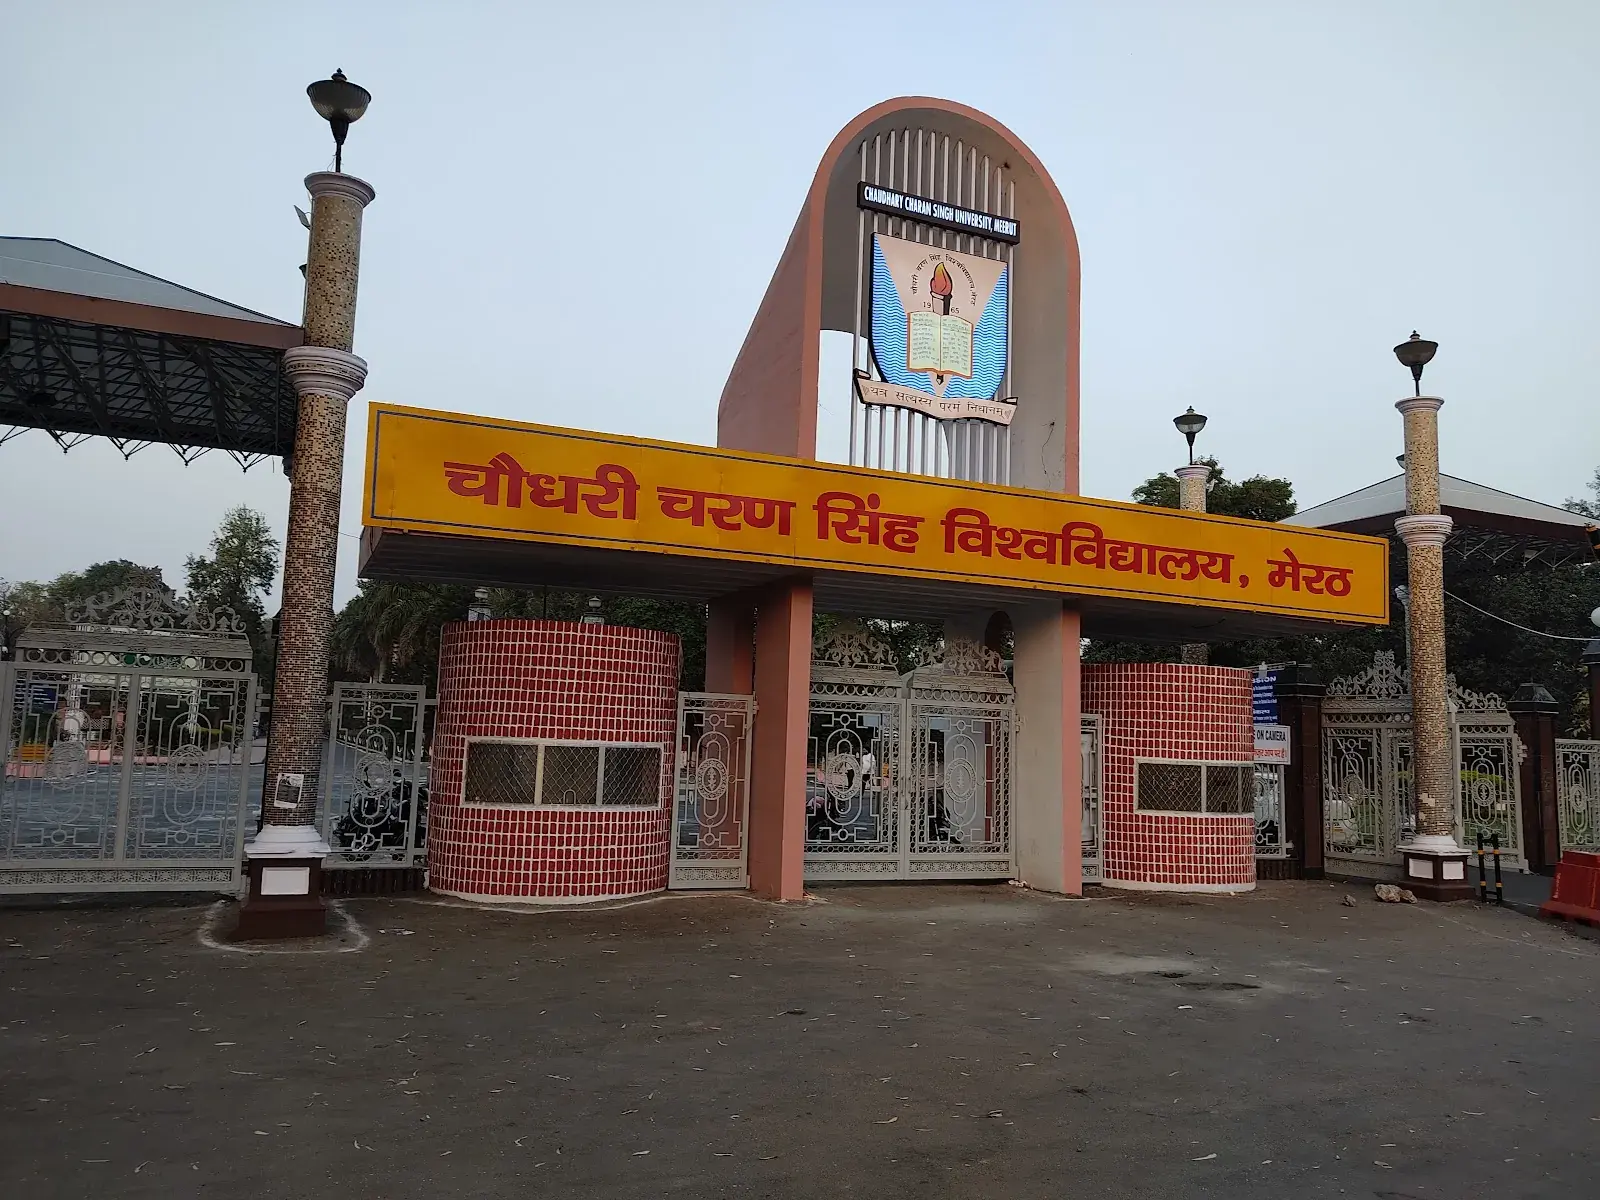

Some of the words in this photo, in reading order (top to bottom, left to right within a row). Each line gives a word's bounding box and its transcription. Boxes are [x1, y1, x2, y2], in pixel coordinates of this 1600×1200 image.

[864, 185, 904, 209] CHAUDHARY
[904, 196, 932, 216] CHARAN
[933, 204, 954, 221] SINGH
[955, 209, 993, 233] UNIVERSITY,
[993, 218, 1017, 236] MEERUT
[923, 301, 932, 309] 19
[950, 306, 960, 314] 65
[870, 386, 888, 398] यत्र
[894, 390, 932, 408] सत्यस्य
[444, 452, 640, 520] चौधरी
[657, 486, 796, 536] चरण
[812, 491, 925, 553] सिंह
[940, 507, 1250, 589] विश्वविद्यालय,
[1267, 548, 1354, 597] मेरठ
[1256, 730, 1265, 740] ON
[1265, 730, 1287, 741] CAMERA
